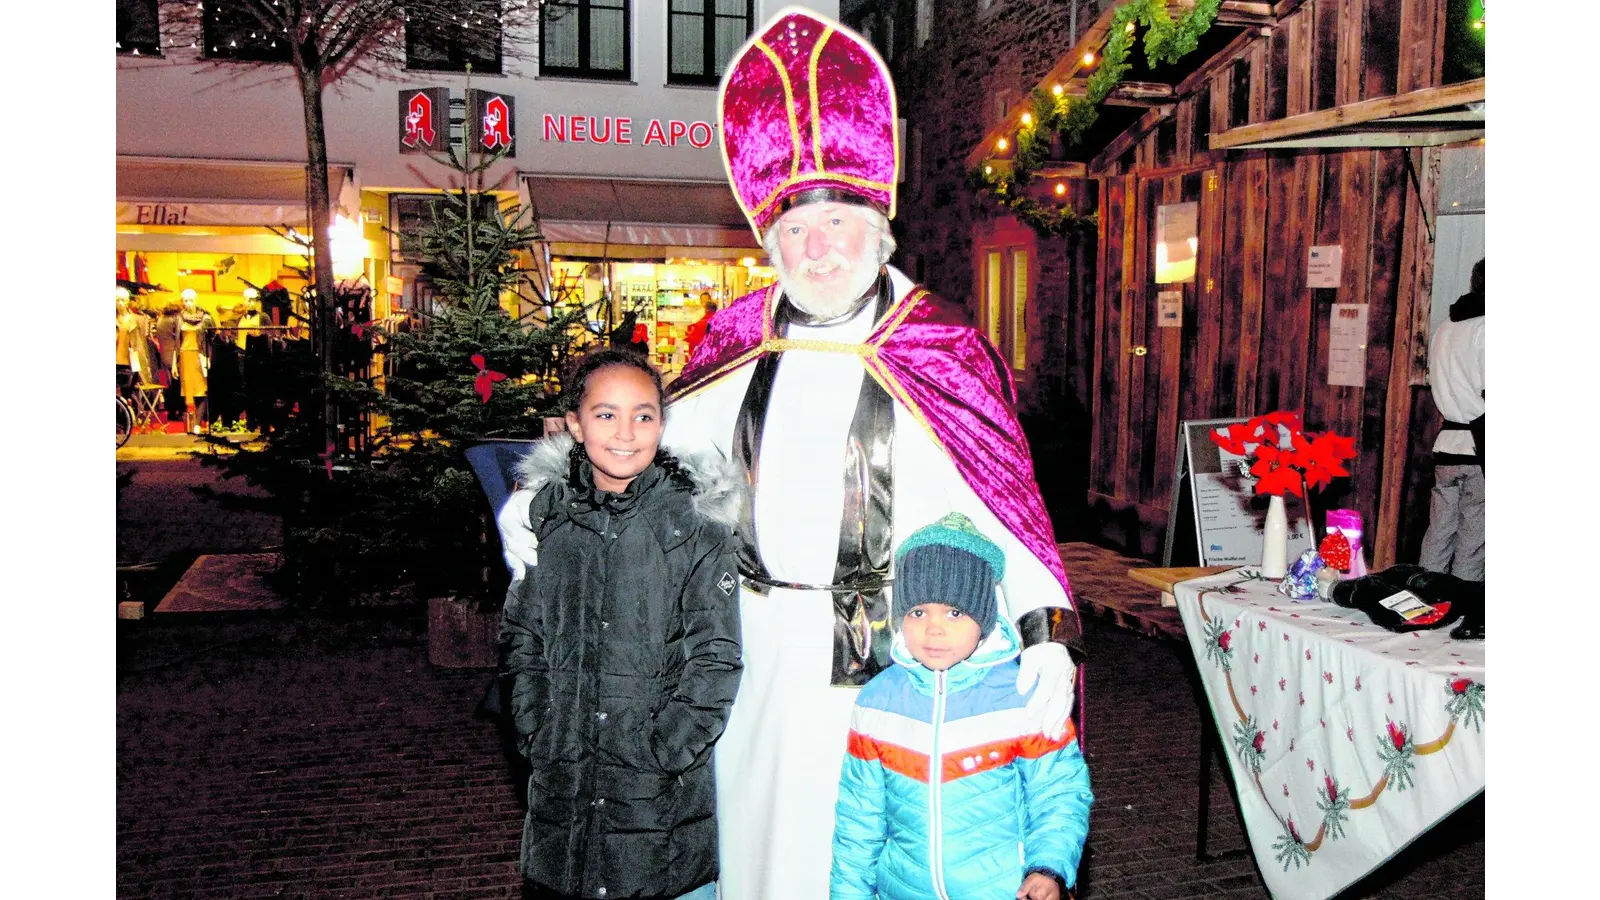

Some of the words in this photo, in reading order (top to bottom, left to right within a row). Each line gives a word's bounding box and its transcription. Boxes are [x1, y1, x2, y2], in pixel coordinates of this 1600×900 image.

[543, 113, 632, 145] NEUE
[643, 119, 719, 149] APO
[136, 204, 188, 225] Ella!
